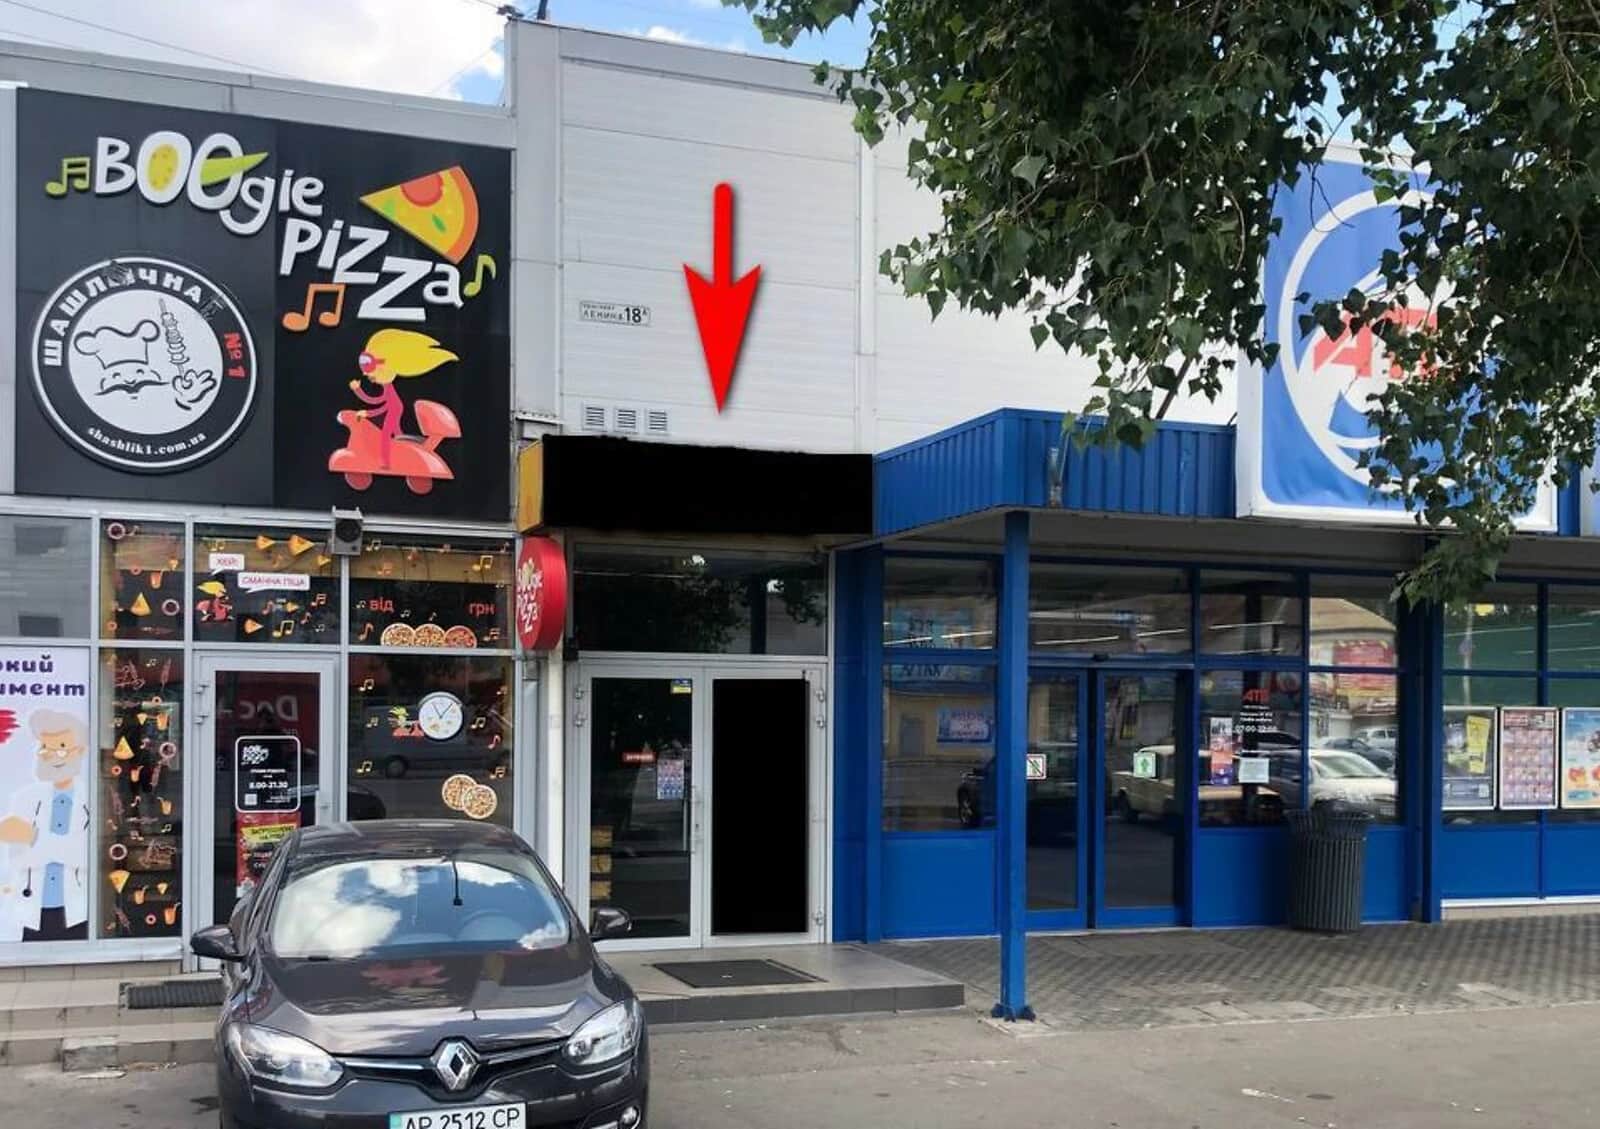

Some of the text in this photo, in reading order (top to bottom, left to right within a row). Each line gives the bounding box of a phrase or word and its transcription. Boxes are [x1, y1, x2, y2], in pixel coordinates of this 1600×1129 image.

[95, 131, 324, 235] BOOgie
[369, 597, 394, 613] від
[469, 602, 496, 617] грн
[0, 654, 53, 673] кий
[440, 1111, 485, 1129] 2512
